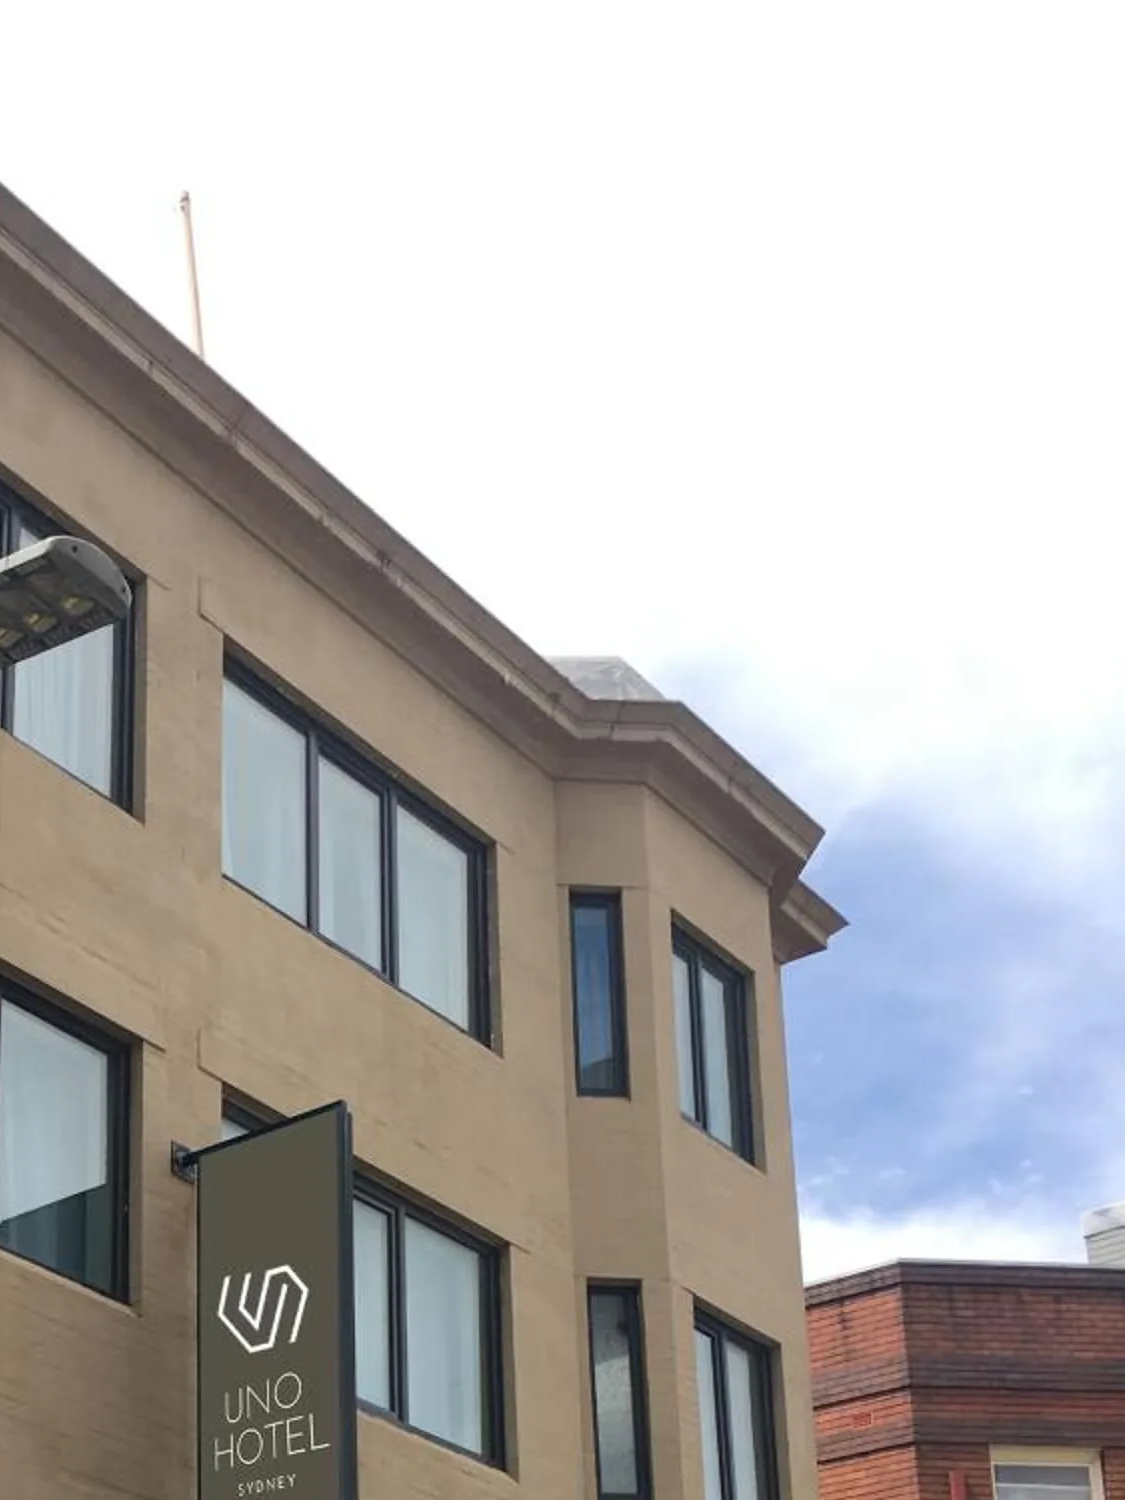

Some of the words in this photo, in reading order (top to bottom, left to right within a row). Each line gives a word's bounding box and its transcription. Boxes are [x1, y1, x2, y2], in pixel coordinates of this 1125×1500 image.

[224, 1371, 303, 1424] UNO
[213, 1413, 331, 1472] HOTEL
[237, 1473, 297, 1498] SYDNEY
